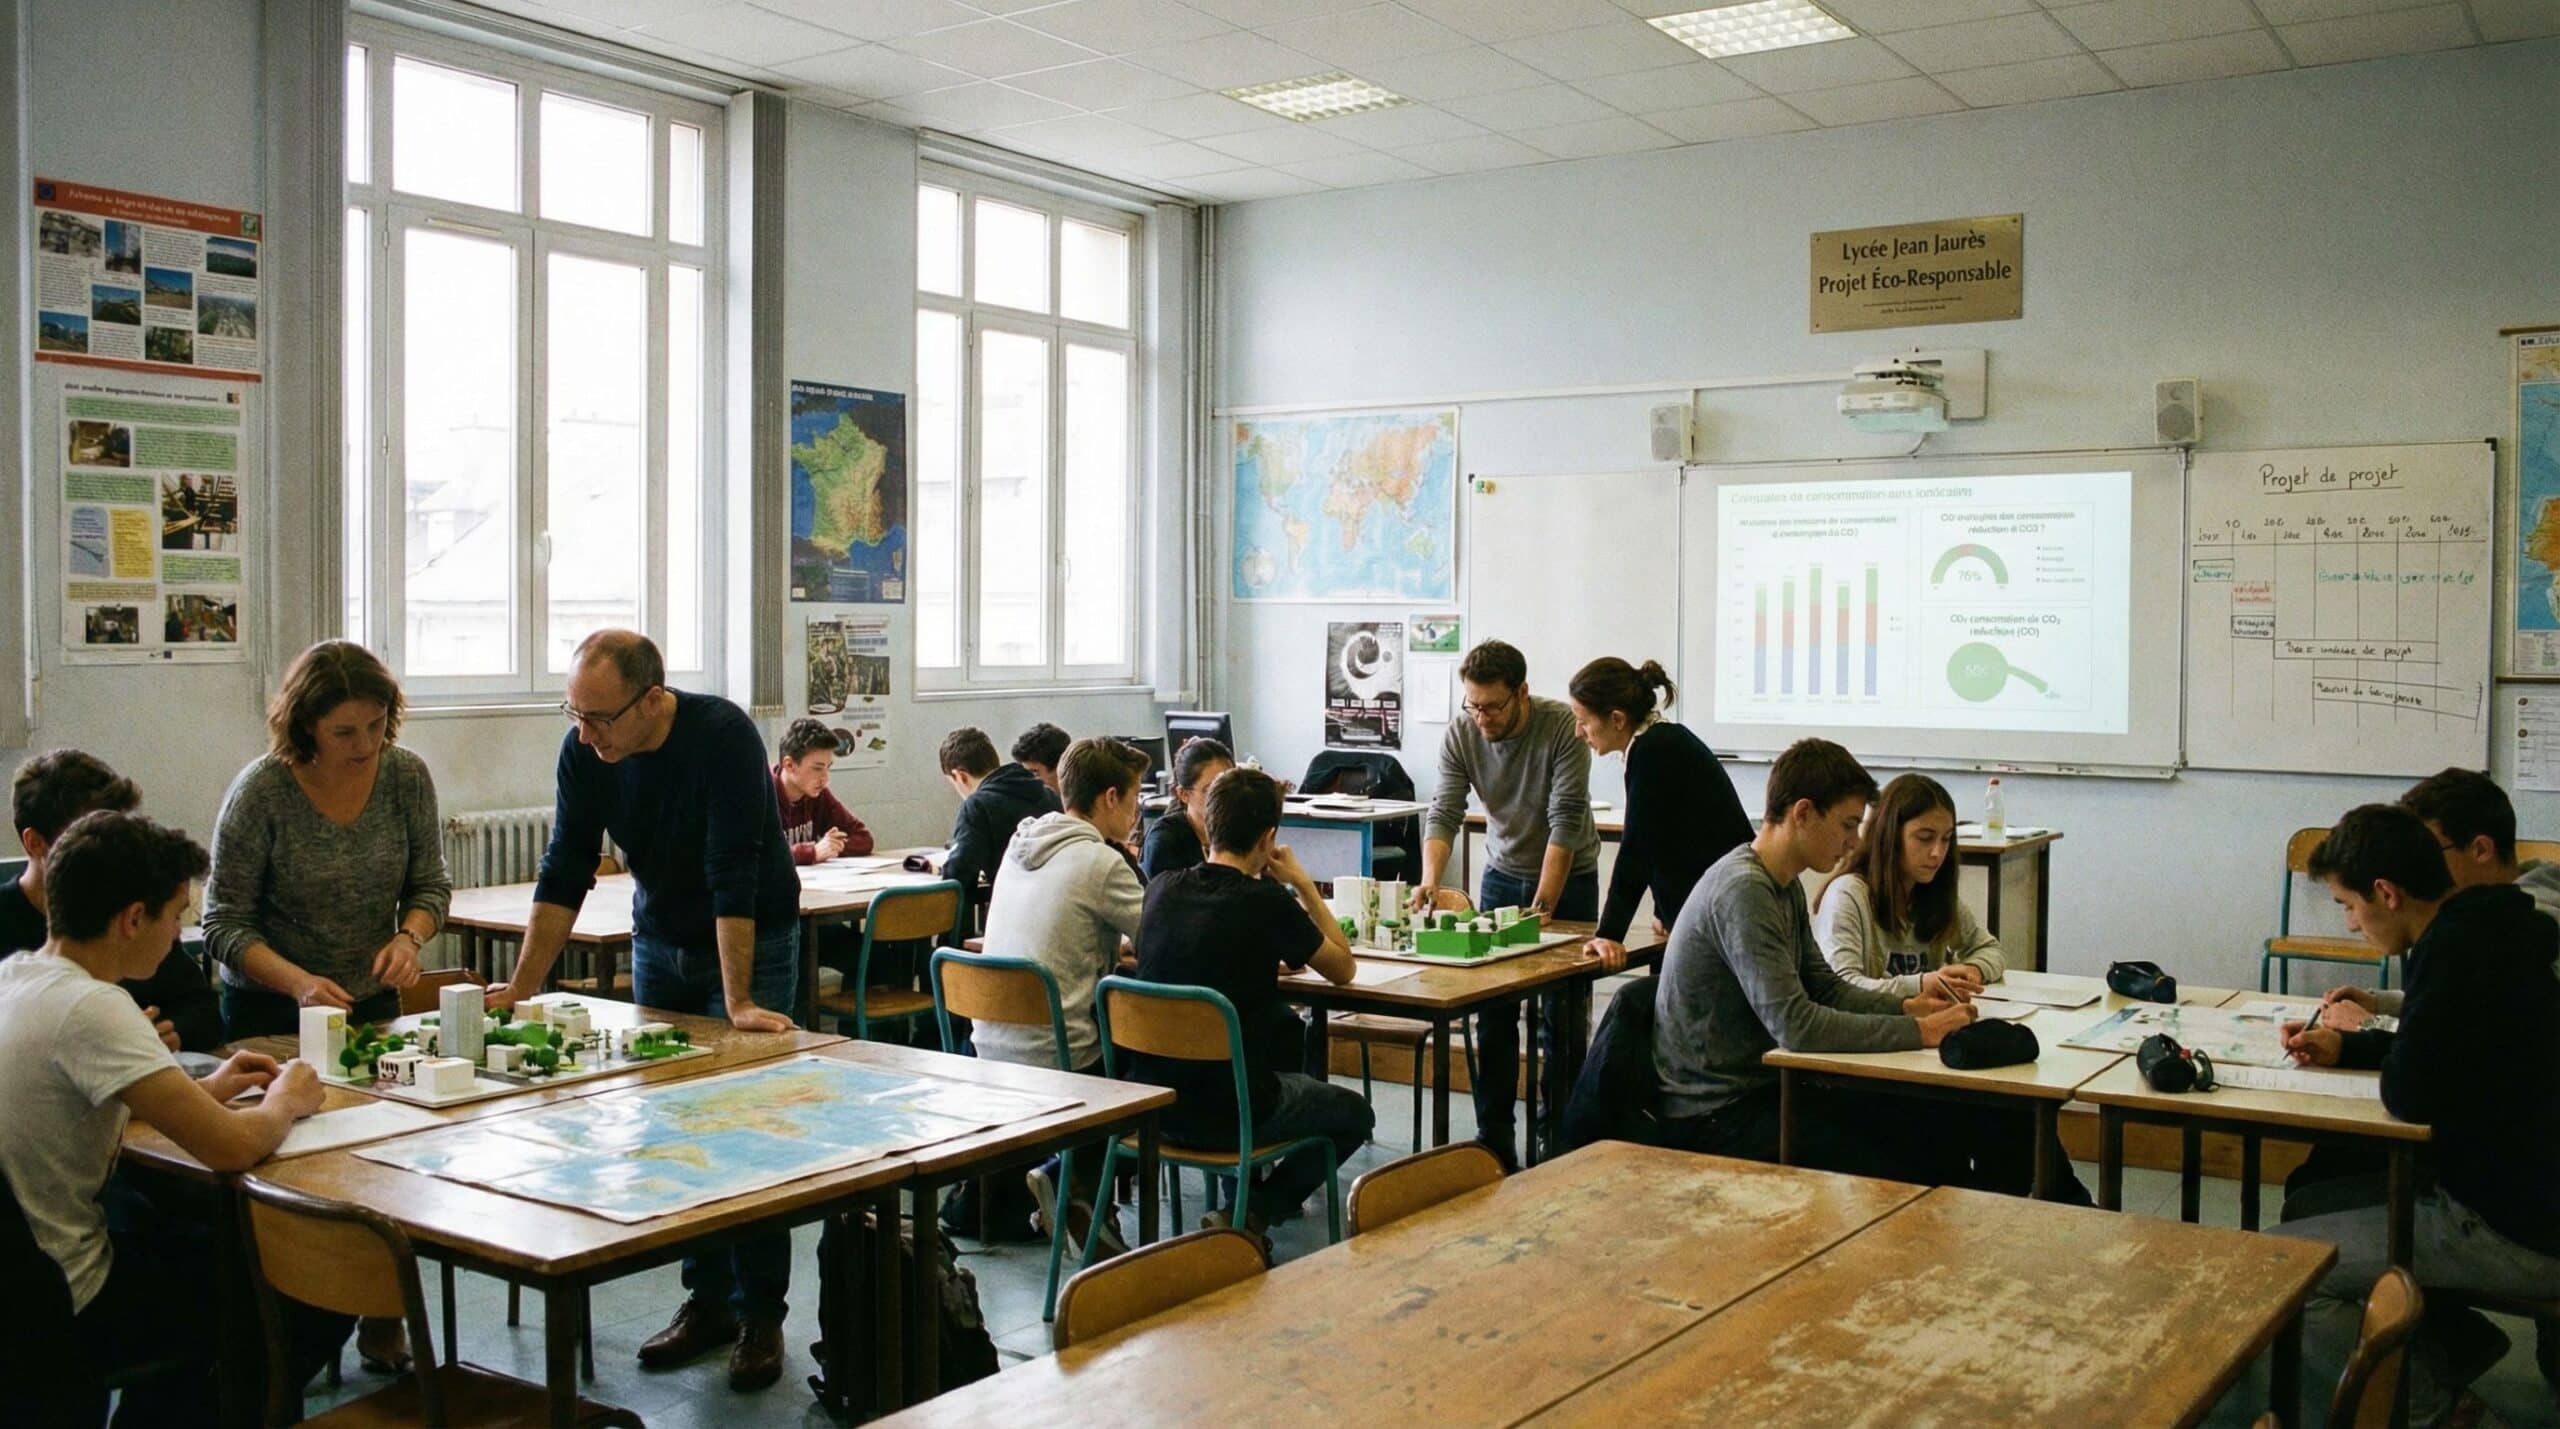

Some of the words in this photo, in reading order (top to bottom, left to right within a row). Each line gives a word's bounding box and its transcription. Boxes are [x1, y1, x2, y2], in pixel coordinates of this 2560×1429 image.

[1842, 239, 1888, 265] Lycée
[1893, 237, 1928, 258] Jean
[1933, 230, 1986, 256] Jaurès
[1819, 273, 1866, 297] Projet
[1872, 260, 2012, 290] Éco-Responsable
[2259, 463, 2309, 493] Projet
[2320, 466, 2336, 483] de
[2349, 463, 2399, 490] projet
